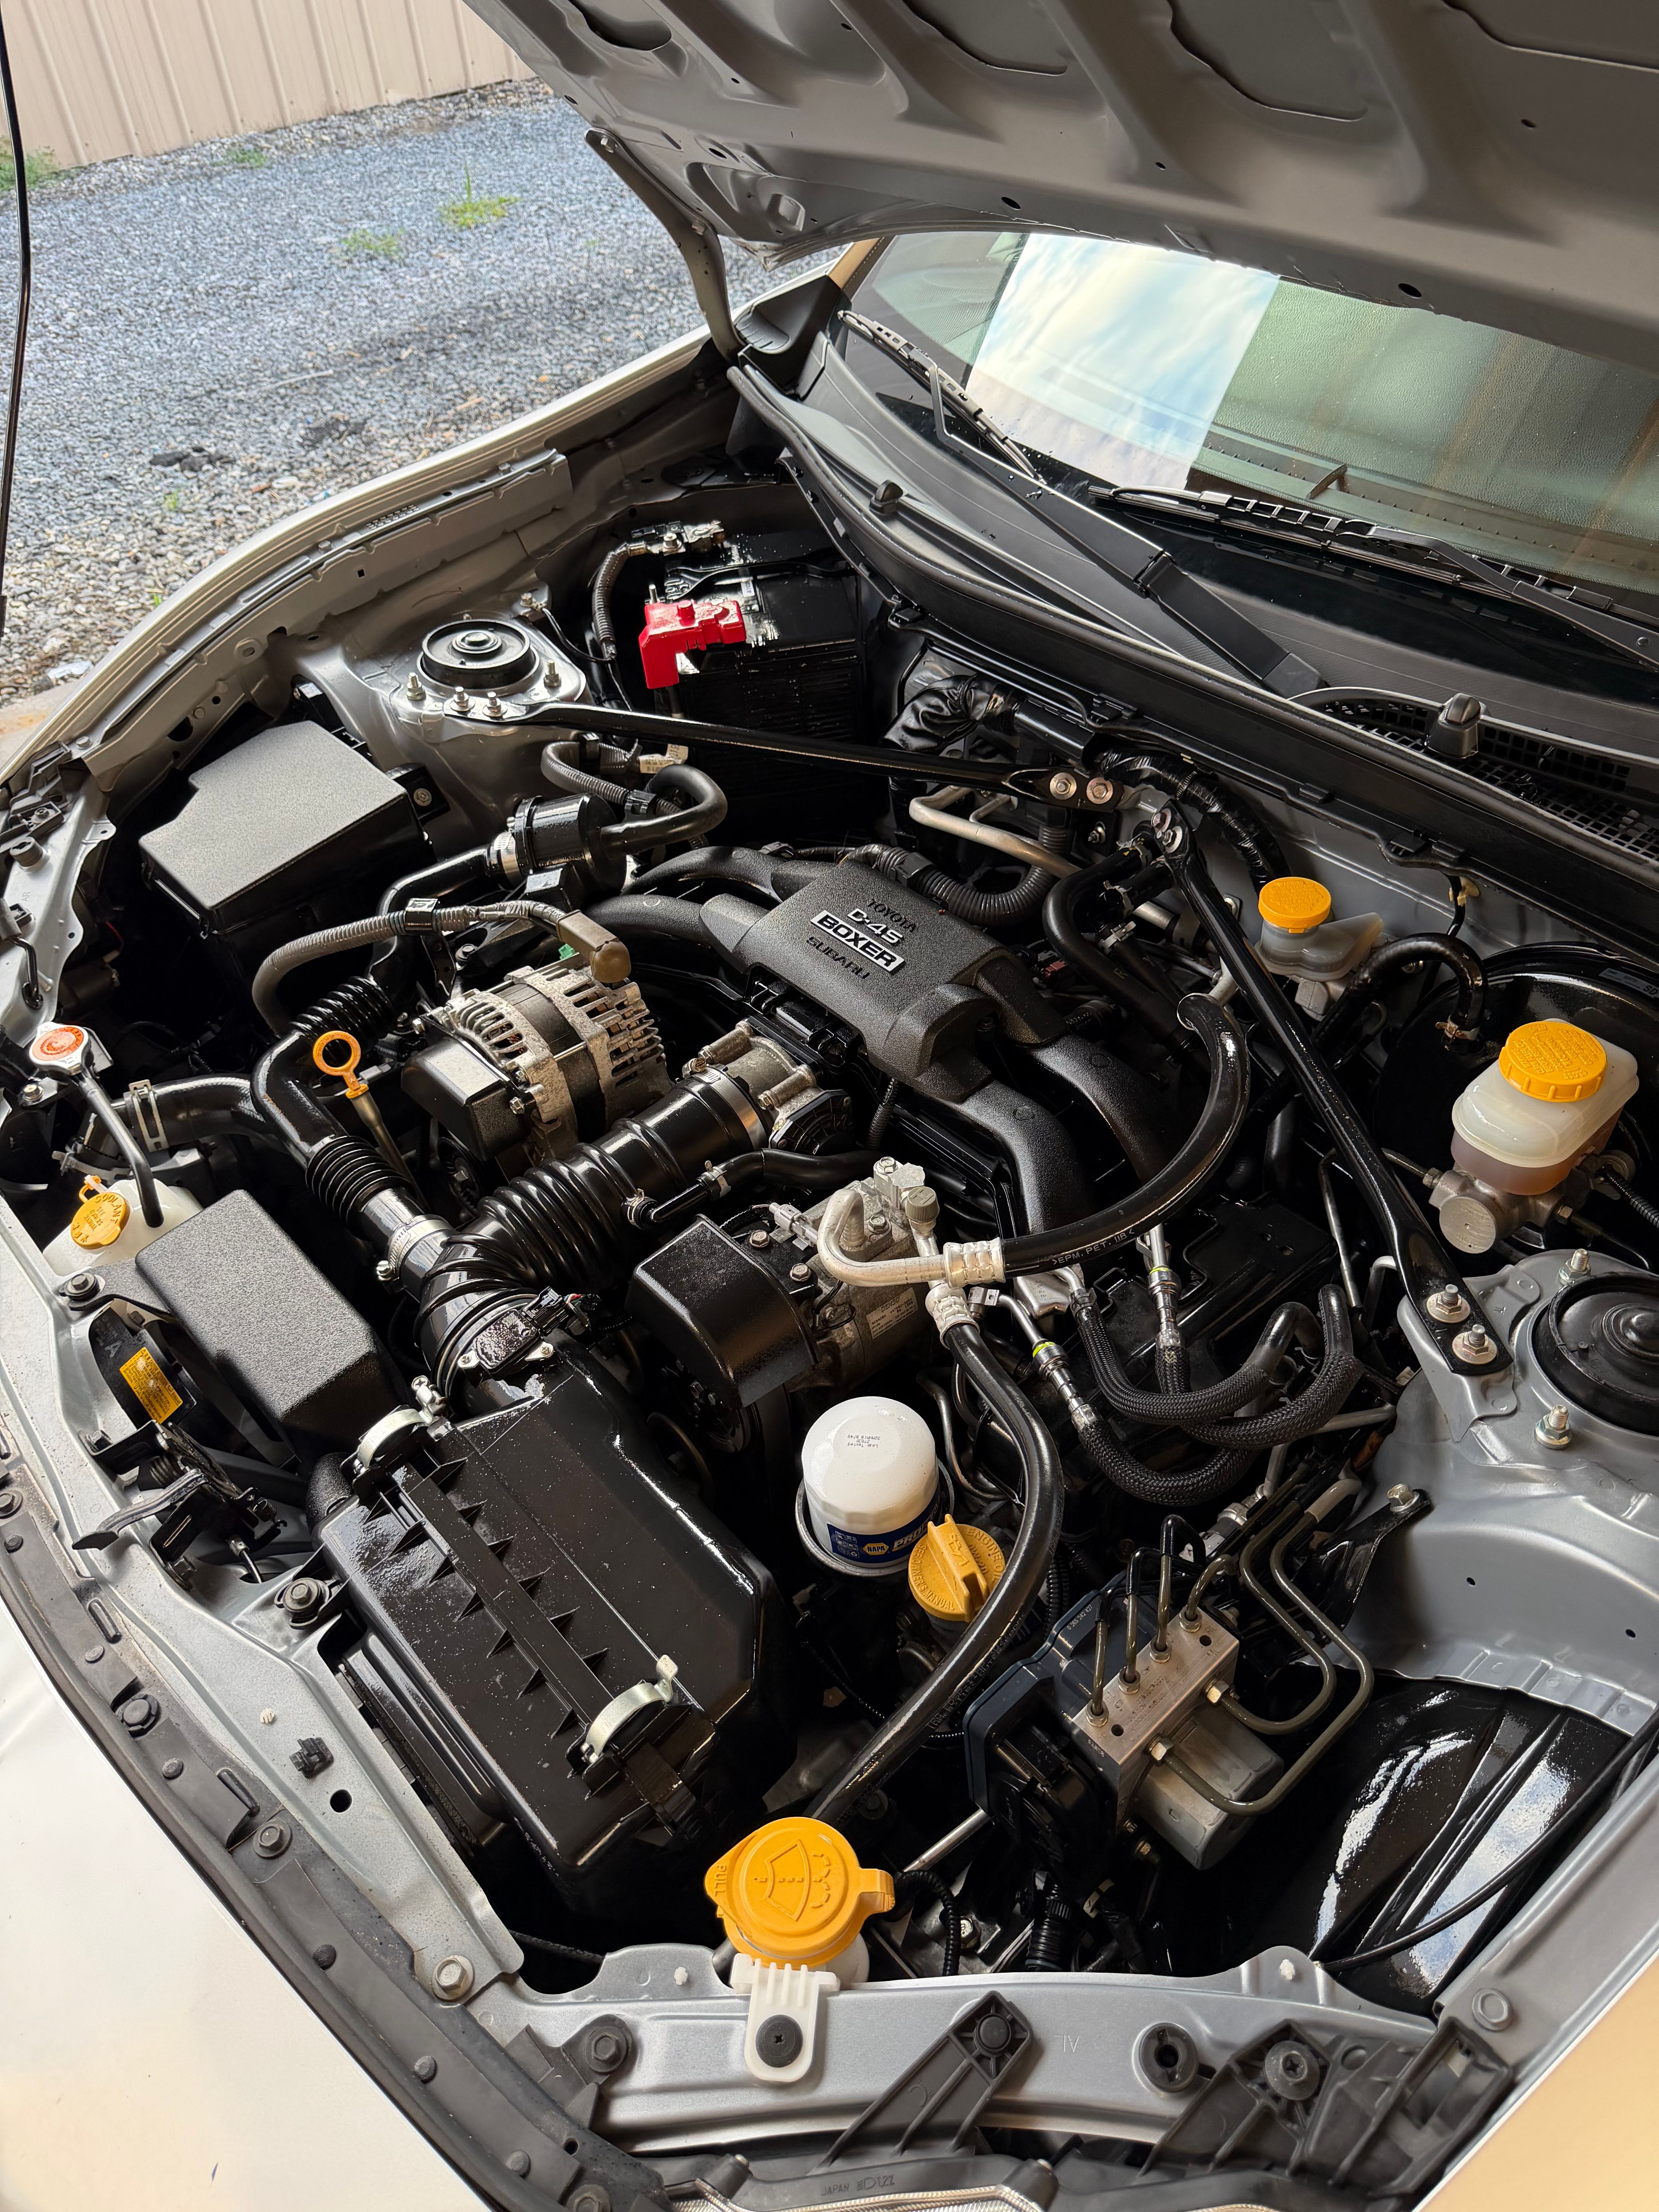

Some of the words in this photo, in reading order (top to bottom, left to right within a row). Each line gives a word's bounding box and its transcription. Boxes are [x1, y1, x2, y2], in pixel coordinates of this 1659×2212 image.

[847, 908, 905, 946] D-4S
[867, 898, 918, 933] TOYOTA
[817, 914, 897, 968] BOXER
[806, 936, 870, 979] SUBARU
[1529, 1023, 1547, 1031] OPEN
[1564, 1070, 1587, 1079] CLOSE
[95, 1194, 122, 1224] COOLANT
[880, 1297, 900, 1312] DENSO
[867, 1544, 886, 1553] NAPA
[918, 1543, 927, 1558] SEE
[966, 1527, 1002, 1561] ENGINE
[991, 1564, 1004, 1582] OIL
[910, 1558, 927, 1592] OWNER'S
[924, 1590, 955, 1611] MANUAL
[714, 1865, 726, 1897] PULL
[822, 2182, 850, 2196] JAPAN
